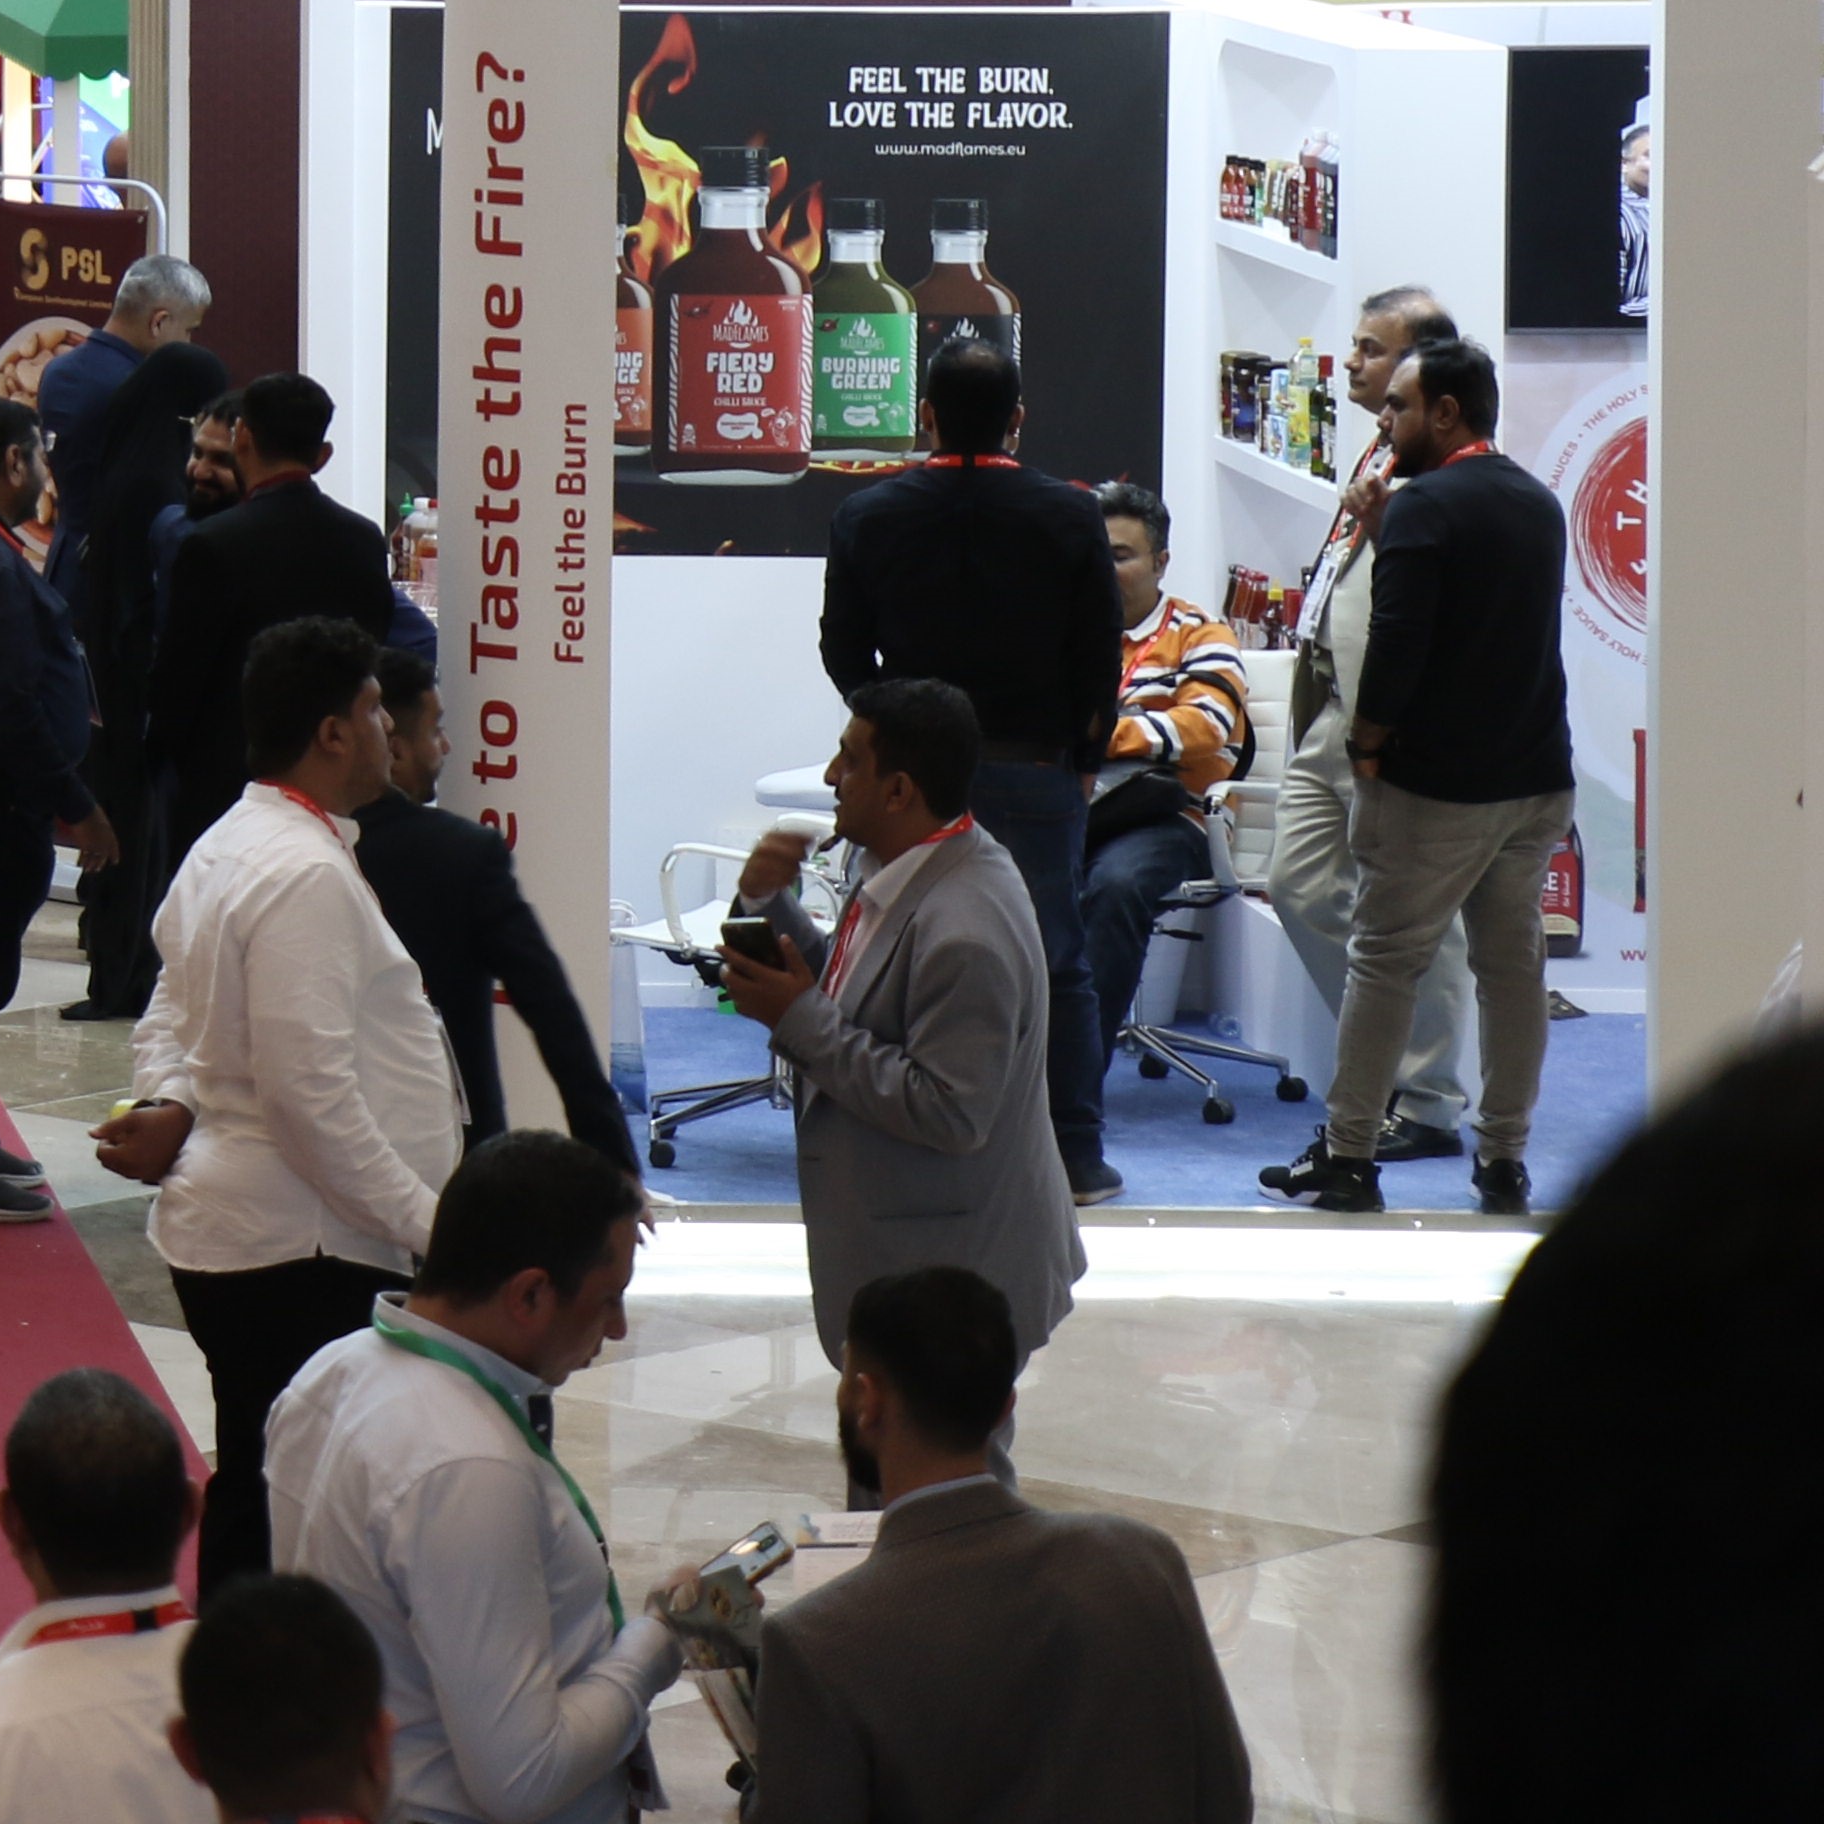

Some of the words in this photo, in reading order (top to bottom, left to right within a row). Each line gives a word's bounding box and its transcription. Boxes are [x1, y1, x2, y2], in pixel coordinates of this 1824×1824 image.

[849, 67, 906, 94] FEEL
[916, 67, 966, 93] THE
[979, 67, 1054, 94] BURN.
[828, 102, 896, 129] LOVE
[905, 102, 955, 128] THE
[967, 102, 1073, 128] FLAVOR.
[474, 50, 526, 255] Fire?
[874, 141, 1026, 158] www.madflames.eu
[61, 246, 112, 284] PSL
[472, 280, 523, 421] the
[706, 352, 774, 373] FIERY
[821, 357, 901, 374] BURNING
[717, 372, 763, 394] RED
[831, 372, 892, 390] GREEN
[1583, 407, 1608, 432] THE
[1606, 387, 1639, 415] HOLY
[555, 402, 587, 497] Burn
[469, 444, 520, 673] Taste
[555, 506, 586, 571] the
[555, 581, 585, 663] Feel
[472, 698, 519, 786] to
